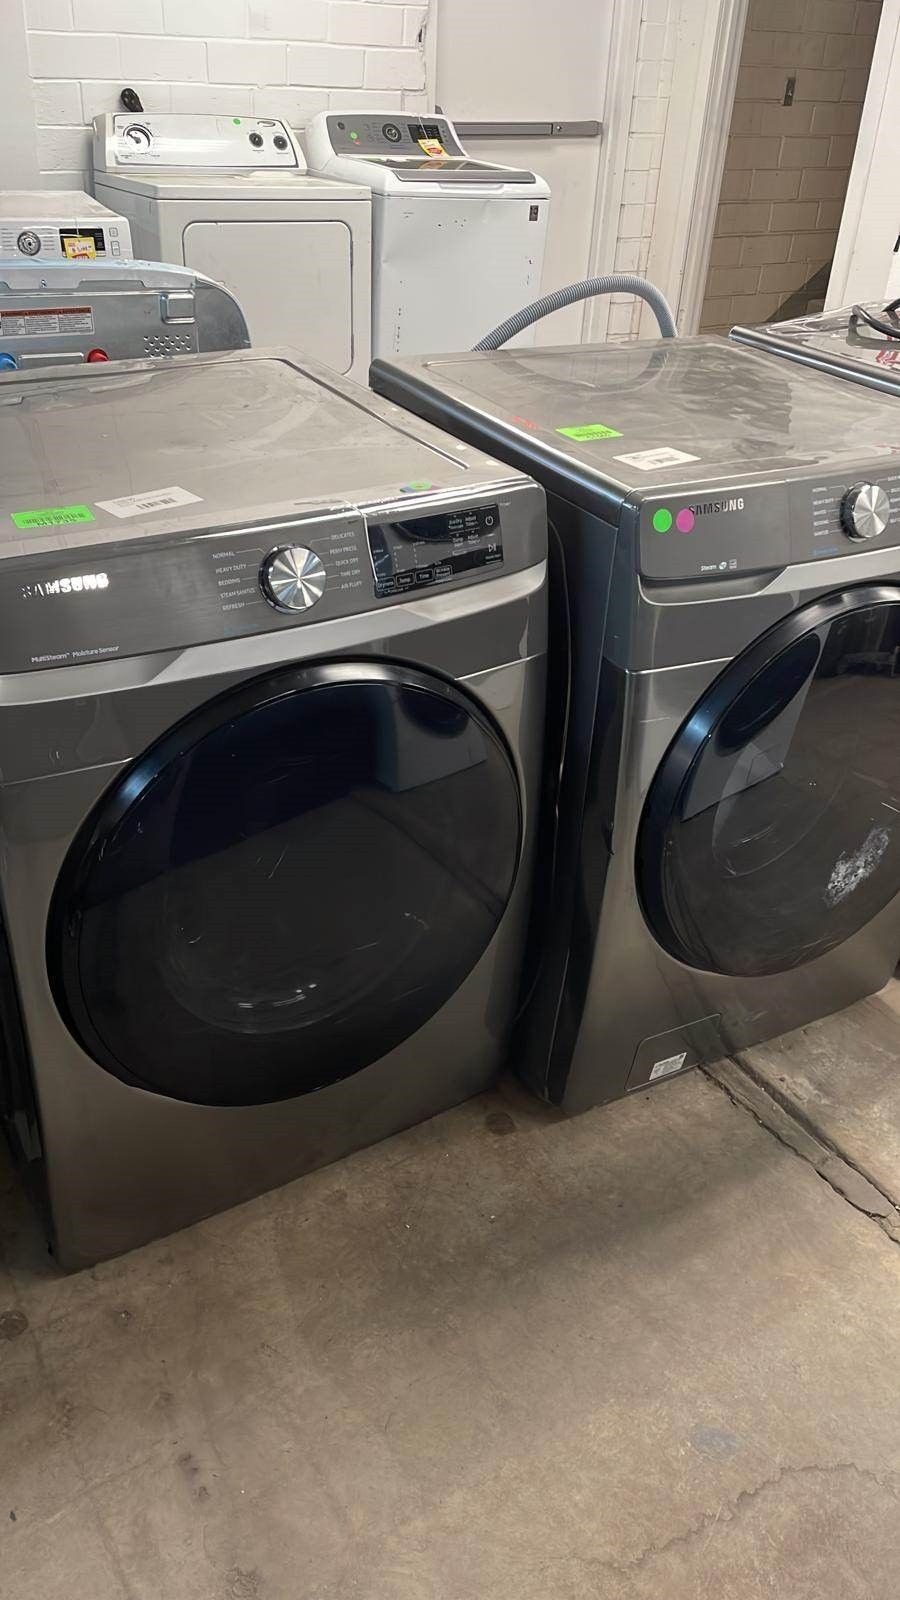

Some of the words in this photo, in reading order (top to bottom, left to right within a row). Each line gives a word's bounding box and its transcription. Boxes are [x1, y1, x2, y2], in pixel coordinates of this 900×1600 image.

[212, 551, 237, 559] NORMAL
[215, 566, 232, 574] HEAVY
[218, 578, 241, 586] BEDDING
